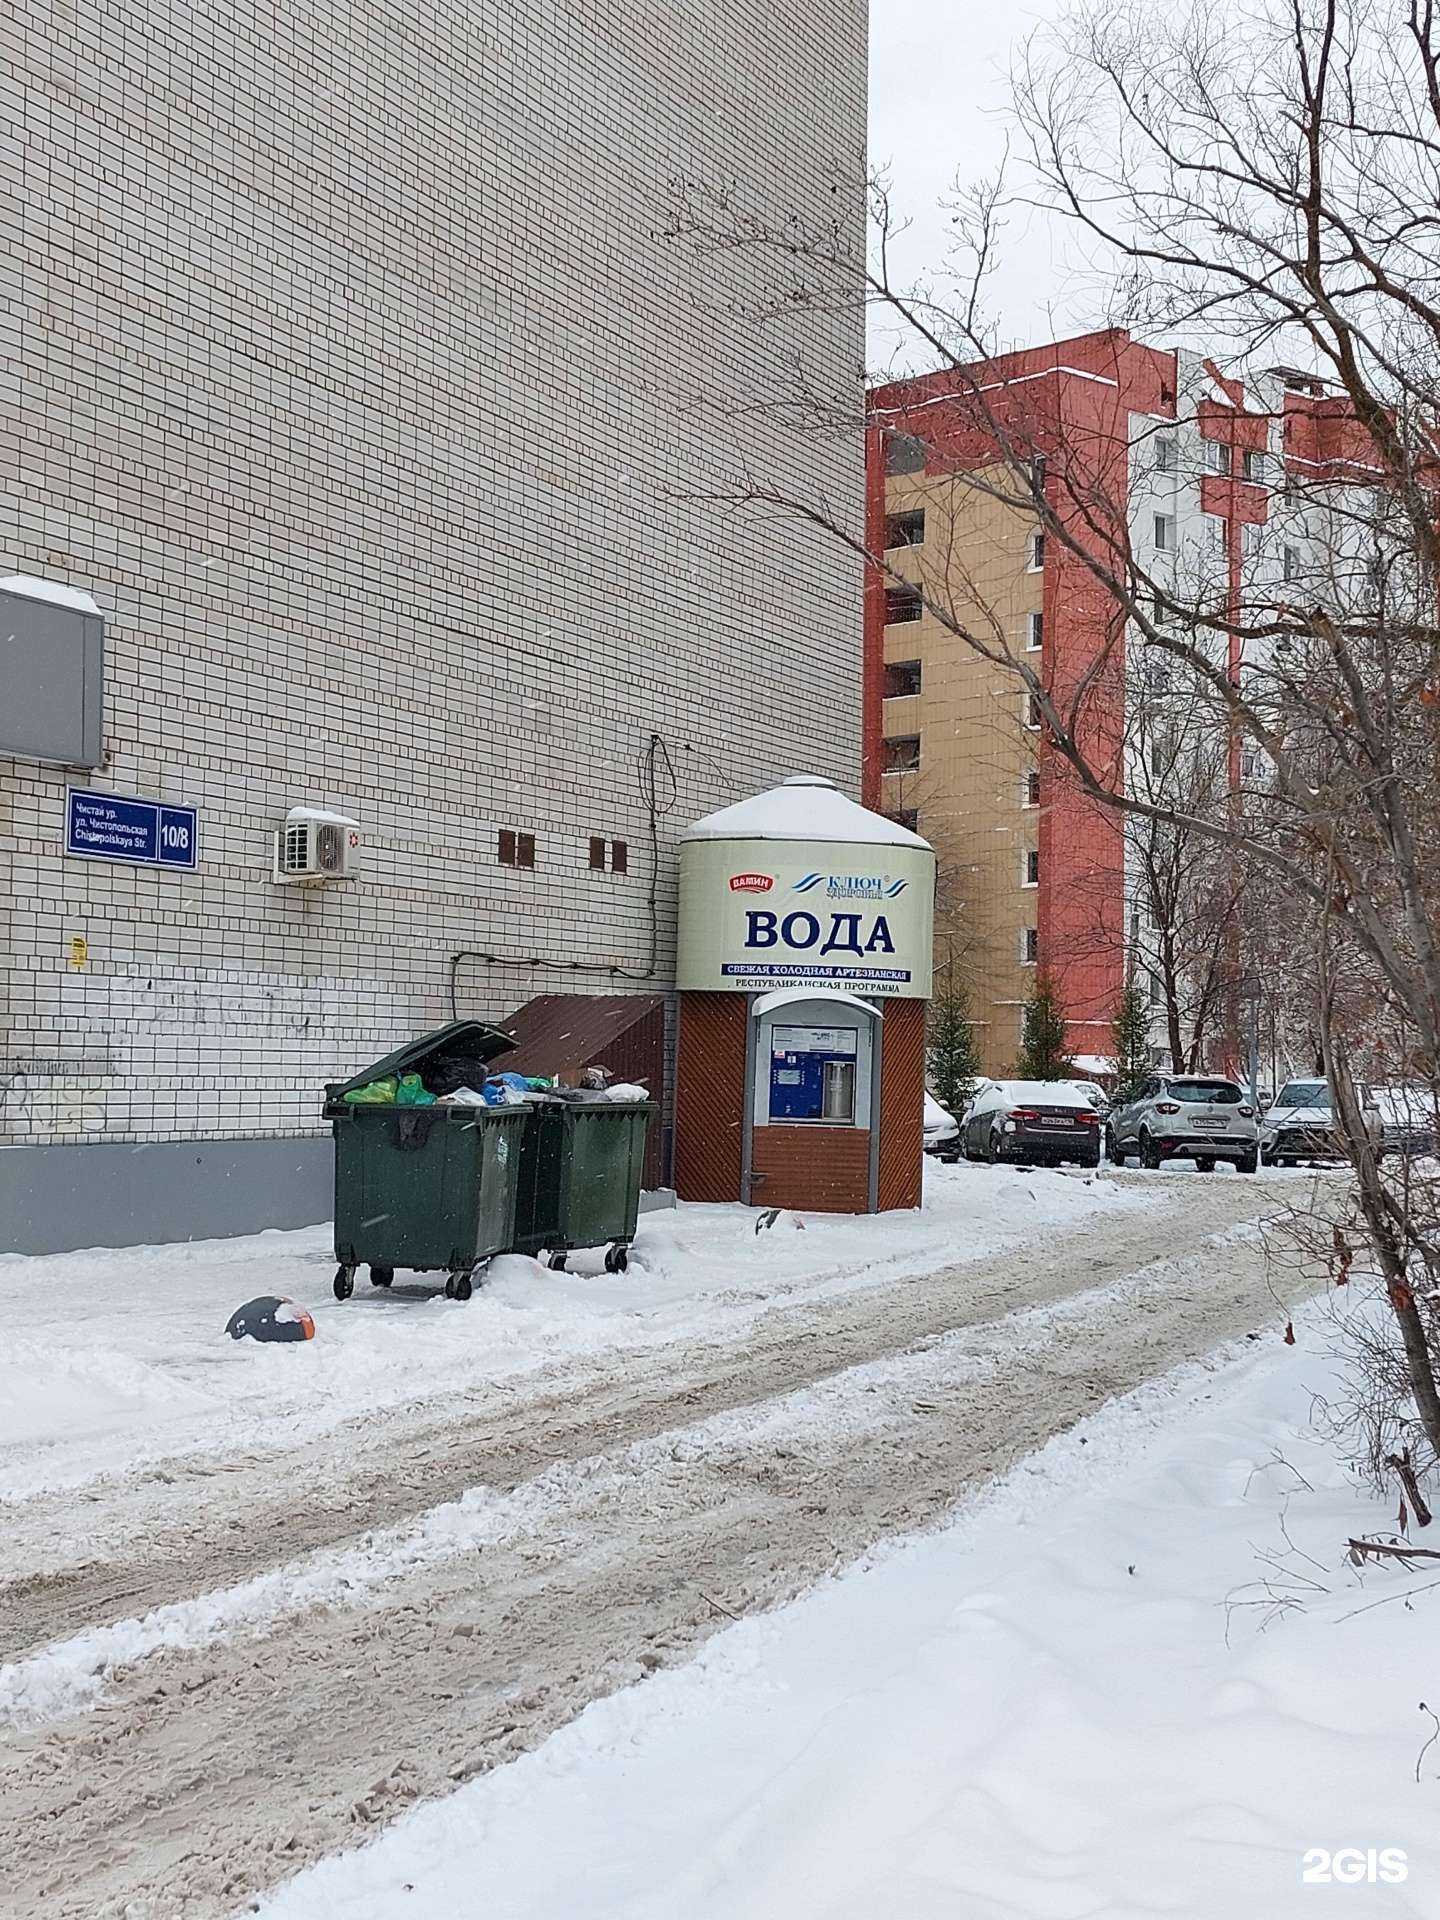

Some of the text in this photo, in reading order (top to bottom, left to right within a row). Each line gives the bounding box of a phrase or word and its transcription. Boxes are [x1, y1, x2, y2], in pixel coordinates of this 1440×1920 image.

[75, 818, 148, 836] ул. Чистопольская
[75, 829, 147, 848] Chistopolskaya Str.
[162, 825, 189, 849] 10/8
[828, 876, 883, 890] КЛЮЧ
[744, 910, 896, 958] ВОДА
[727, 965, 907, 981] СВЕЖАЯ ХОЛОДНАЯ АРТЕЗИАНСКАЯ
[735, 978, 901, 993] РЕСПУБЛИКАНСКАЯ ПРОГРАММА
